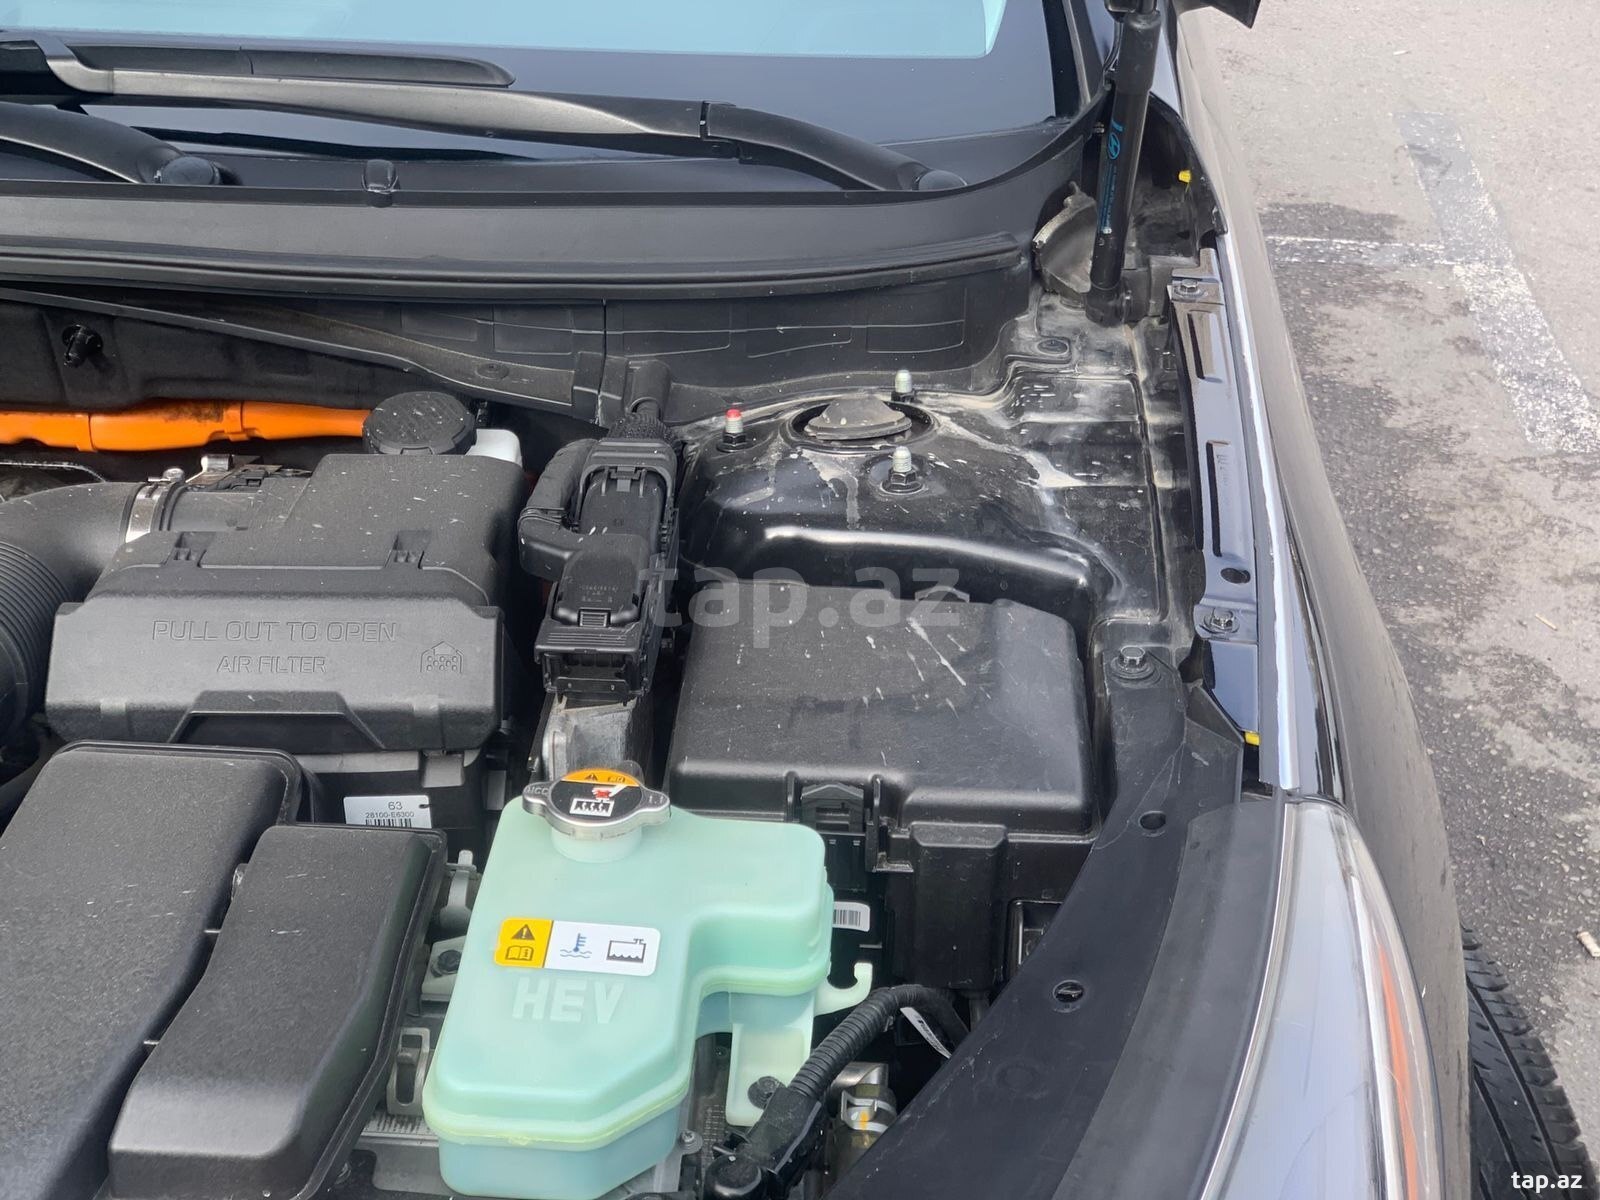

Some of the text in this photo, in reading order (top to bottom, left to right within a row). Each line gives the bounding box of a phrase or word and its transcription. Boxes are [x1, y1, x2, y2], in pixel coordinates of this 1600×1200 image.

[152, 620, 397, 643] PULL OUT TO OPEN
[216, 655, 328, 674] AIR FILTER
[365, 811, 415, 819] 28100-E6300
[387, 801, 403, 811] 63
[511, 976, 625, 1024] HEV
